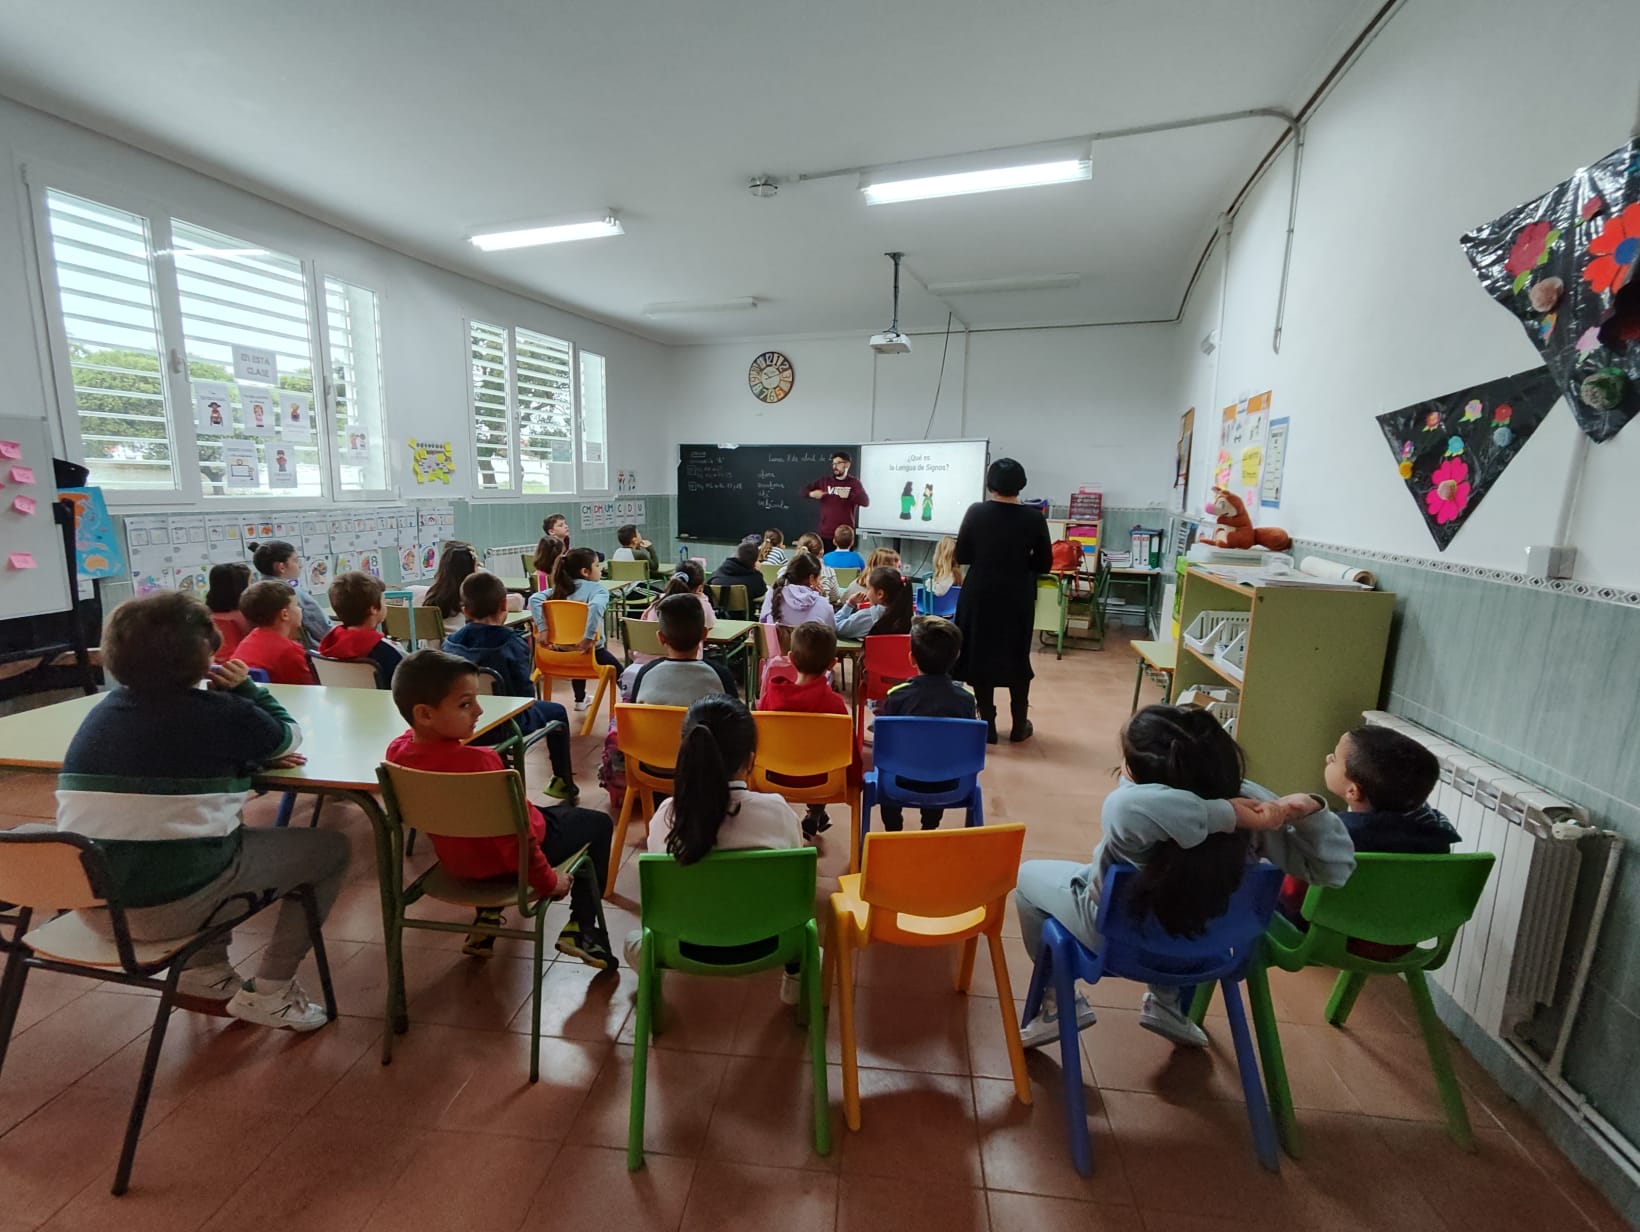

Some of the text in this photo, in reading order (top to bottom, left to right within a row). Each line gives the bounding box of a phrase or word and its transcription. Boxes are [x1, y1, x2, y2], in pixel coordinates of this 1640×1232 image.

[252, 355, 271, 366] ESTA
[247, 367, 270, 378] CLASE
[907, 454, 923, 463] ¿Qué
[895, 464, 916, 472] Lengua
[926, 464, 950, 472] Signos?
[582, 505, 591, 514] CM
[605, 503, 614, 513] UM
